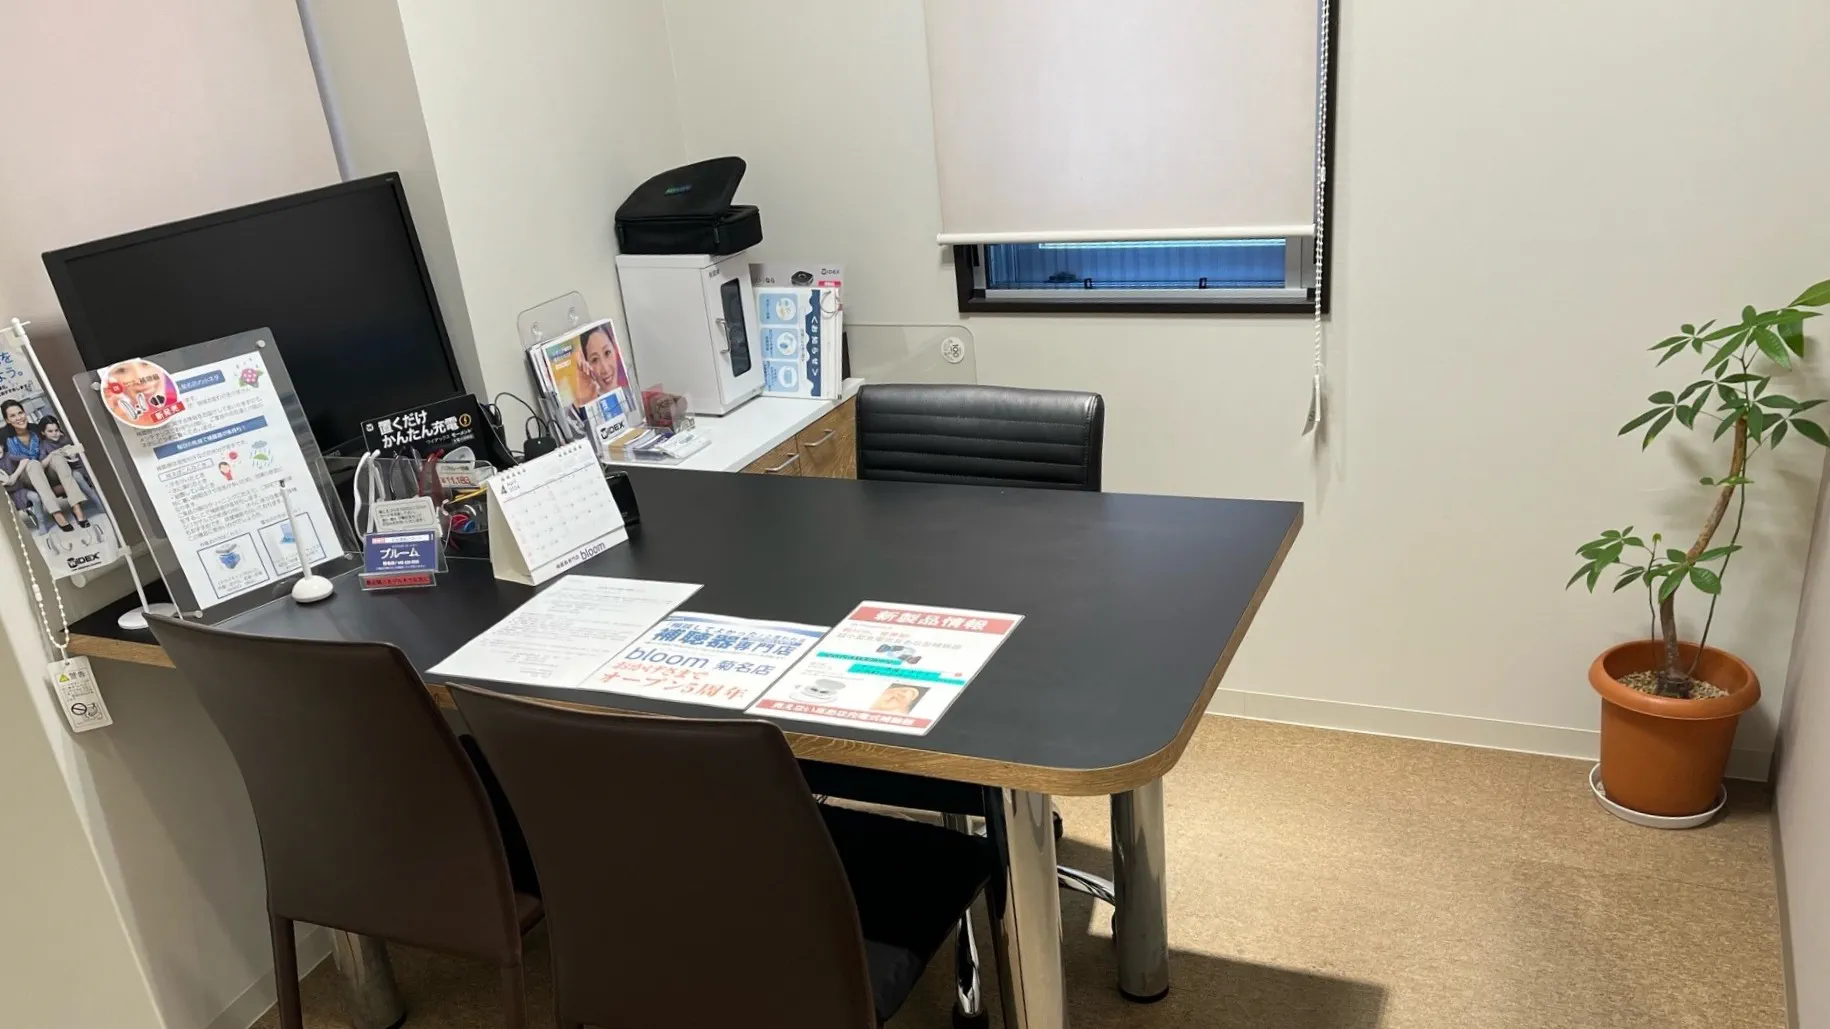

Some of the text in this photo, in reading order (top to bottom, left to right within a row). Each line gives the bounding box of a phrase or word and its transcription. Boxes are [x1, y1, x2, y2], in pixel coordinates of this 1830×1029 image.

[155, 404, 181, 420] 新発売
[378, 410, 427, 435] 置くだけ
[382, 416, 459, 448] かんたん充電
[600, 421, 625, 439] WIDEX
[67, 552, 100, 569] WIDEX
[380, 547, 421, 560] ブルーム
[580, 542, 606, 560] bloom
[874, 610, 989, 631] 新製品情報
[652, 628, 798, 656] 補聴器専門店
[625, 647, 710, 669] bloom
[713, 660, 776, 677] 菊名店
[600, 671, 748, 700] オープン5周年
